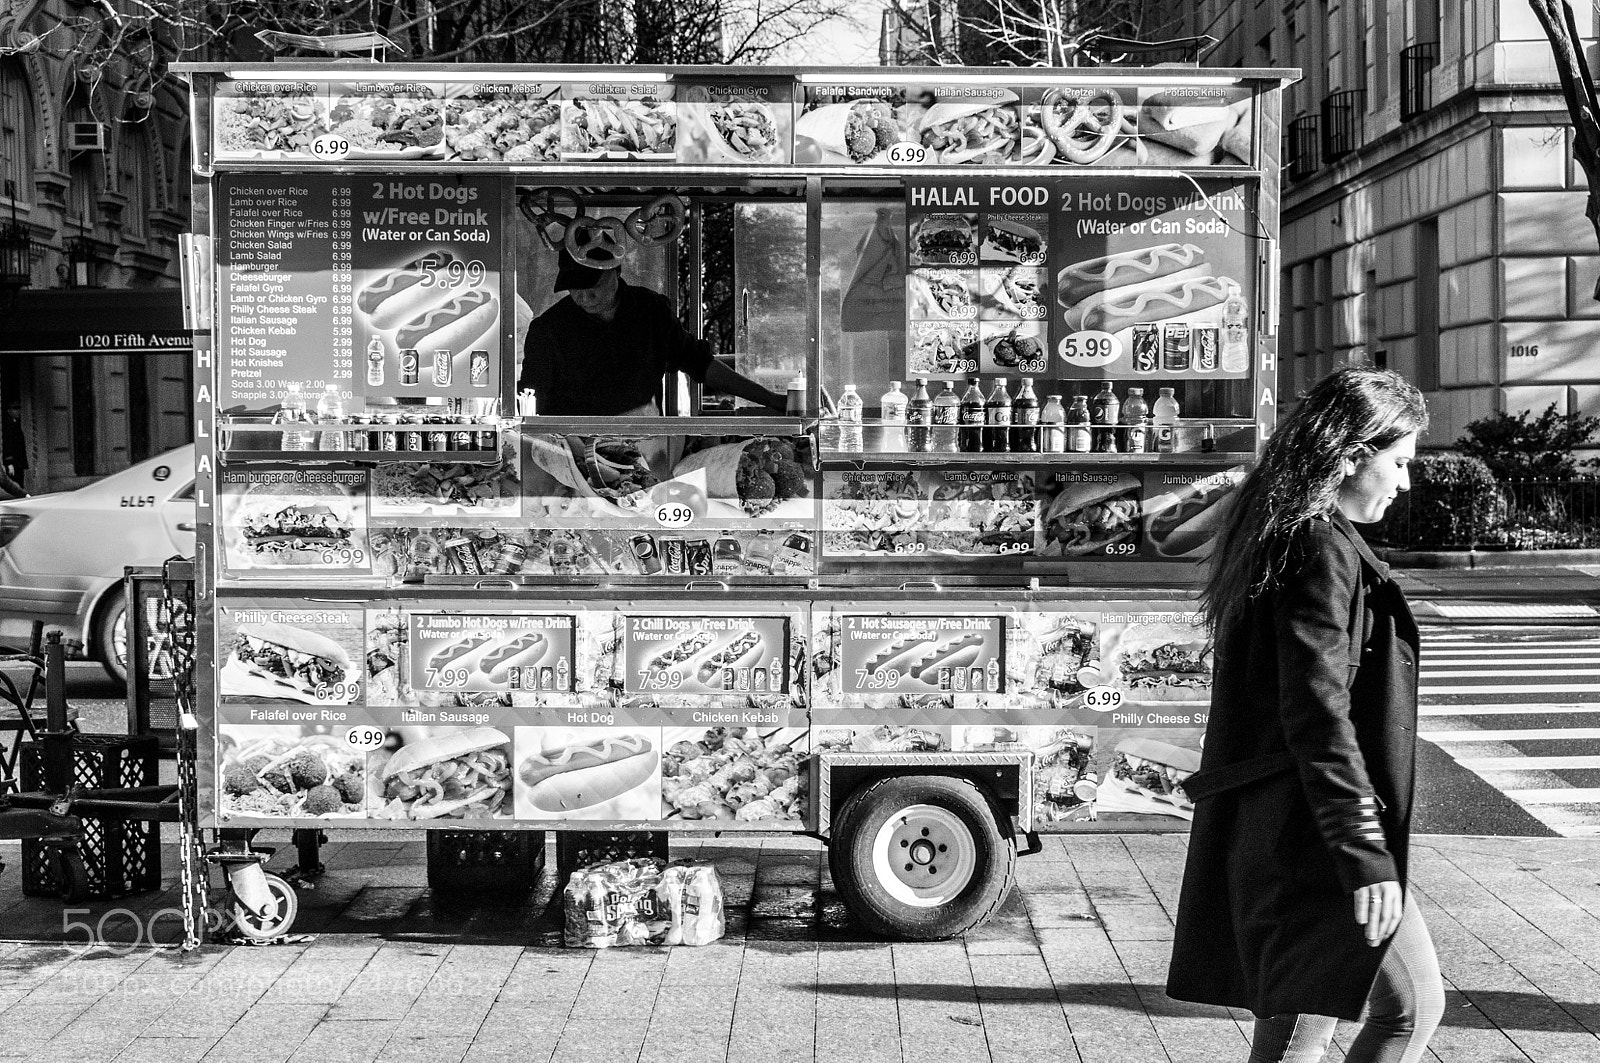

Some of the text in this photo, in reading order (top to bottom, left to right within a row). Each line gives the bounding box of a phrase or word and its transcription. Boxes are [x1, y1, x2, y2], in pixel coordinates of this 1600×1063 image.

[235, 82, 318, 93] Chicken over Rice
[356, 83, 427, 93] Lamb over Rice
[473, 84, 542, 94] Chicken Kebab
[589, 84, 657, 95] Chicken Salad
[708, 85, 769, 97] Chicken Gyro
[815, 86, 892, 97] Falafel Sandwich
[934, 87, 1004, 99] Italian Sausage
[1065, 87, 1096, 97] Pretzel
[1164, 88, 1227, 98] Potatos Knish
[314, 140, 349, 154] 6.99
[891, 148, 926, 163] 6.99
[229, 186, 352, 196] Chicken over Rice 6.99
[372, 182, 478, 205] 2 Hot Dogs
[911, 186, 1049, 206] HALAL FOOD
[1061, 191, 1246, 215] 2 Hot Dogs w/Drink
[363, 207, 489, 226] w/Free Drink
[229, 218, 352, 229] Chicken Finger w/Fries 6.99
[1076, 217, 1230, 238] (Water or Can Soda)
[362, 228, 490, 243] (Water or Can Soda)
[230, 240, 352, 250] Chicken Salad 6.99
[949, 251, 977, 264] 6.99
[1019, 251, 1047, 264] 6.99
[230, 262, 352, 272] Hamburger 6.99
[230, 273, 352, 283] Cheeseburger 6.99
[420, 259, 487, 289] 5.99
[230, 283, 352, 294] Falafel Gyro 6.99
[230, 294, 352, 305] Lamb or Chicken Gyro 6.99
[230, 304, 352, 315] Philly Cheese Steak 6.99
[949, 305, 978, 318] 6.99
[1020, 305, 1047, 318] 6.99
[231, 326, 353, 336] Chicken Kebab 5.99
[79, 335, 110, 347] 1020
[114, 333, 145, 347] Fifth
[231, 337, 353, 347] Hot Dog 2.99
[1064, 337, 1113, 357] 5.99
[1510, 345, 1539, 357] 1016
[949, 359, 977, 373] 7.99
[1018, 359, 1047, 373] 6.99
[231, 369, 353, 379] Pretzel 2.99
[196, 350, 212, 507] HALAL
[223, 471, 365, 485] Ham burger or Cheeseburger
[842, 472, 877, 482] Chicken
[944, 472, 967, 482] Lamb
[969, 472, 990, 483] Gyro
[1055, 472, 1118, 484] Italian Sausage
[1163, 474, 1193, 485] Jumbo
[658, 508, 692, 522] 6.99
[894, 542, 925, 554] 6.99
[999, 542, 1030, 554] 6.99
[1105, 543, 1136, 555] 6.99
[321, 549, 364, 564] 6.99
[234, 611, 349, 625] Philly Cheese Steak
[417, 617, 572, 630] 2 Jumbo Hot Dogs w/Free Drink
[848, 618, 991, 631] 2 Hot Sausages w/Free Drink
[1101, 612, 1124, 624] Ham
[1127, 612, 1159, 626] burger
[1161, 615, 1171, 624] or
[632, 619, 640, 630] 2
[665, 618, 690, 632] Dogs
[692, 618, 726, 630] w/Free
[728, 618, 756, 630] Drink
[424, 668, 470, 688] 7.99
[638, 669, 683, 690] 7.99
[855, 668, 900, 689] 7.99
[314, 682, 360, 701] 6.99
[1087, 691, 1121, 706] 6.99
[250, 709, 347, 721] Falafel over Rice
[401, 711, 490, 724] Italian Sausage
[567, 712, 614, 725] Hot Dog
[692, 711, 779, 723] Chicken Kebab
[1112, 713, 1144, 727] Philly
[1147, 713, 1190, 724] Cheese
[348, 732, 383, 745] 6.99
